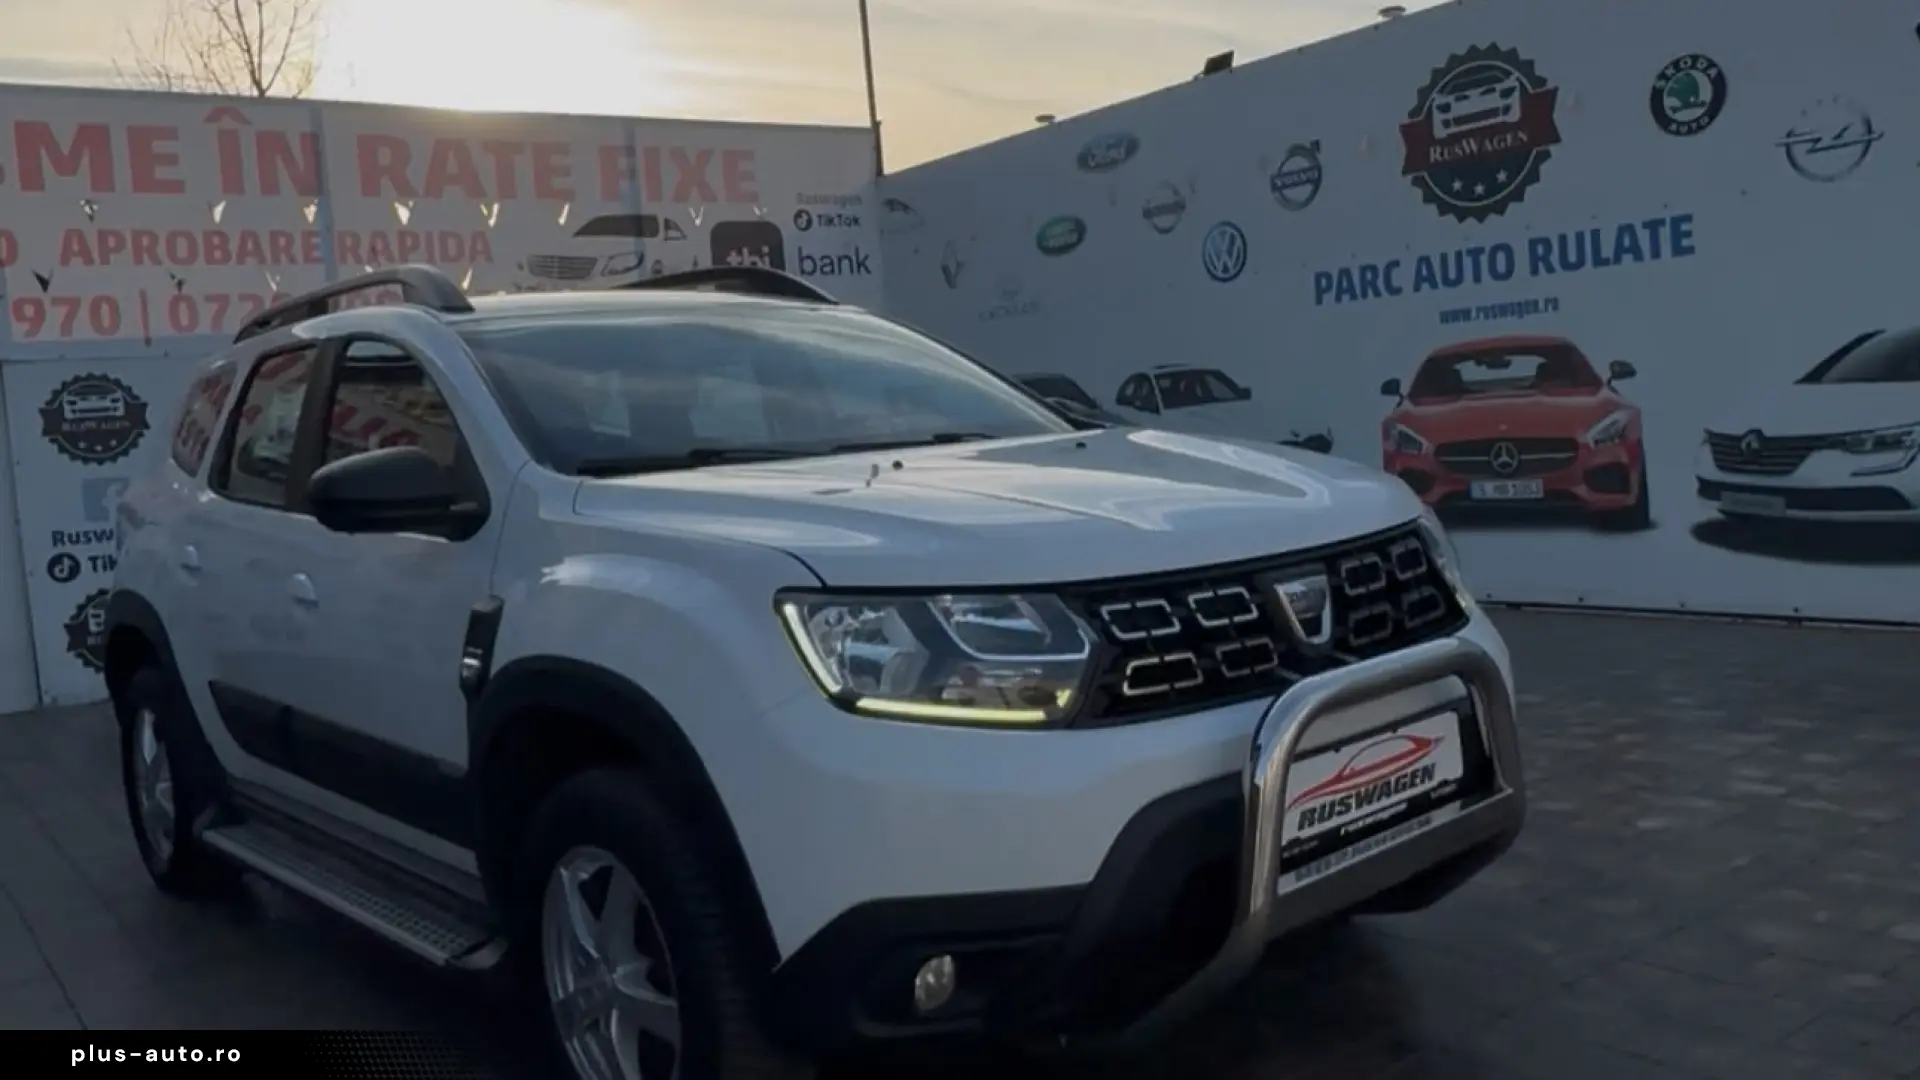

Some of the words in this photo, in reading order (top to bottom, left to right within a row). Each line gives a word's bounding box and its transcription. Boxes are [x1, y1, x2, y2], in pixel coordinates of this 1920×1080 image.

[0, 119, 186, 195] ME
[204, 106, 322, 197] ÎN
[356, 132, 577, 202] RATE
[595, 143, 760, 205] FIXE
[58, 227, 324, 267] APROBARE
[336, 228, 494, 265] RAPIDA
[798, 245, 872, 276] bank
[1313, 258, 1403, 306] PARC
[1413, 242, 1515, 293] AUTO
[1528, 213, 1696, 277] RULATE
[11, 294, 121, 339] 970
[1297, 762, 1436, 832] RUSWAGEN
